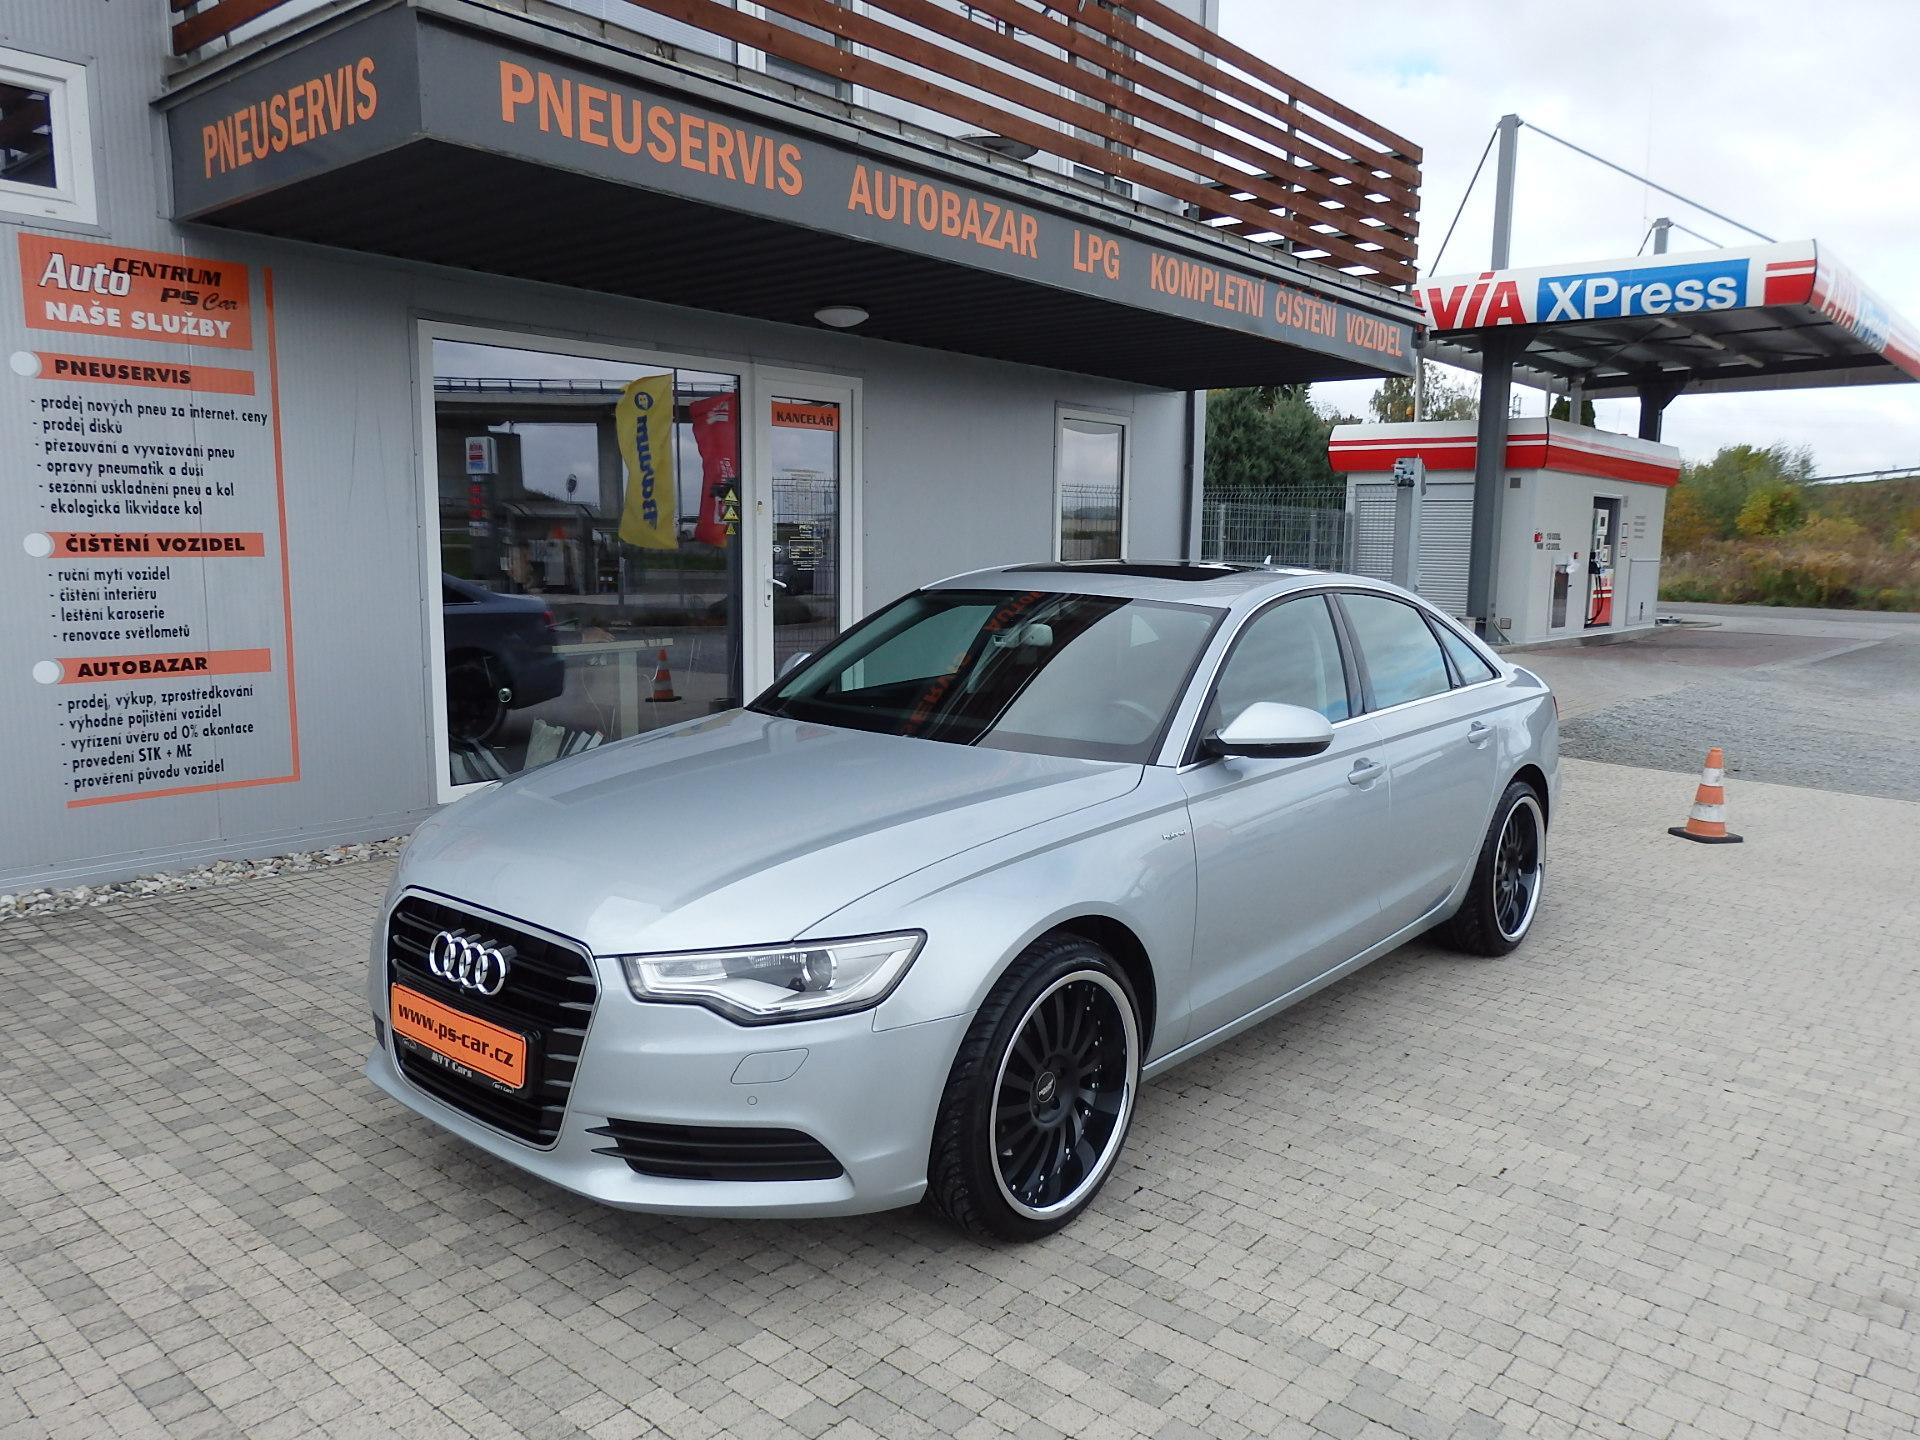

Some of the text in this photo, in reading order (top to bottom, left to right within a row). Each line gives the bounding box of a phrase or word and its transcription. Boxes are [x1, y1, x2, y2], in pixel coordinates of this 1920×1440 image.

[202, 56, 378, 180] PNEUSERVIS
[500, 60, 804, 196] PNEUSERVIS
[847, 164, 1039, 259] AUTOBAZAR
[1073, 229, 1121, 280] LPG
[1150, 253, 1266, 316] KOMPLETNÍ
[1345, 312, 1403, 358] VOZIDEL
[38, 252, 223, 297] Auto CENTRUM
[160, 288, 201, 306] PS
[1547, 276, 1738, 322] XPress
[45, 300, 232, 339] NAŠE SLUŽBY
[54, 359, 192, 385] PNEUSERVIS
[41, 395, 84, 414] prodej
[87, 399, 133, 416] nových
[138, 403, 167, 418] pneu
[171, 407, 185, 418] za
[242, 412, 268, 426] ceny
[776, 411, 834, 426] KANCELÁŘ
[43, 416, 85, 436] prodej
[122, 443, 129, 454] a
[208, 447, 235, 461] pneu
[47, 461, 93, 477] opravy
[98, 461, 164, 477] pneumatik
[169, 466, 176, 476] a
[173, 485, 201, 498] pneu
[205, 486, 212, 495] a
[216, 482, 234, 496] kol
[125, 500, 180, 515] likvidace
[184, 500, 202, 515] kol
[66, 533, 246, 553] ČIŠTĚNÍ VOZIDEL
[58, 568, 90, 581] ruční
[127, 565, 170, 581] vozidel
[107, 605, 165, 620] karoserie
[63, 630, 120, 642] renovace
[77, 656, 208, 678] AUTOBAZAR
[181, 703, 222, 720] vozidel
[163, 725, 177, 740] od
[181, 724, 199, 738] 0%
[202, 723, 254, 737] akontace
[138, 747, 161, 762] STK
[176, 743, 192, 758] ME
[184, 758, 225, 776] vozidel
[398, 1003, 514, 1068] www.ps-car.cz
